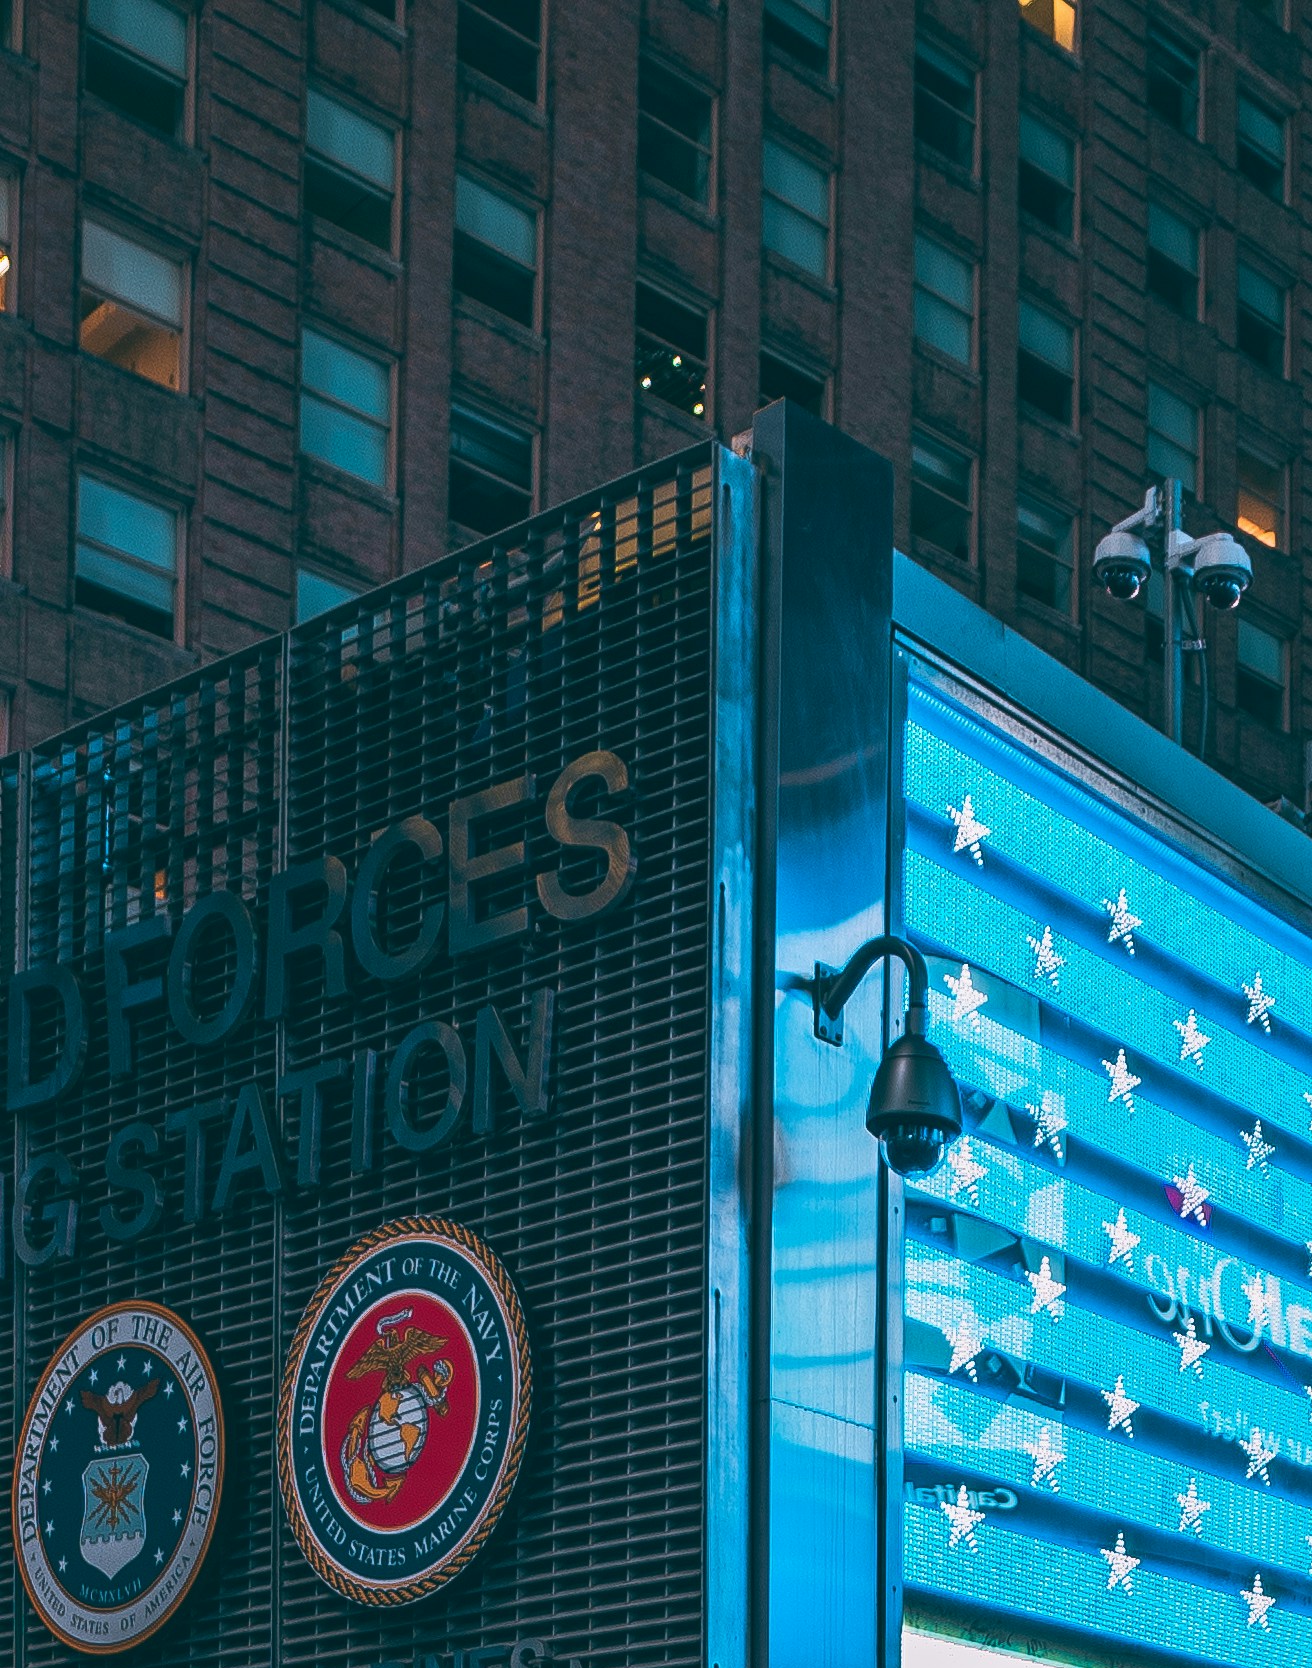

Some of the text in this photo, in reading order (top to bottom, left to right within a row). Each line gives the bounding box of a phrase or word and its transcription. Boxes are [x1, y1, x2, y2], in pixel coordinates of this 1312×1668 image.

[8, 749, 638, 1112] D FORCES
[0, 986, 557, 1266] G STATION
[18, 1312, 217, 1545] DEPARTMENT OF THE AIR FORCE
[299, 1257, 503, 1436] DEPARTMENT OF THE NAVY
[305, 1398, 503, 1567] UNITED STATES MARINE CORPS
[34, 1556, 192, 1637] UNITED STATES OF AMERICA
[79, 1580, 142, 1603] MCMXLVII
